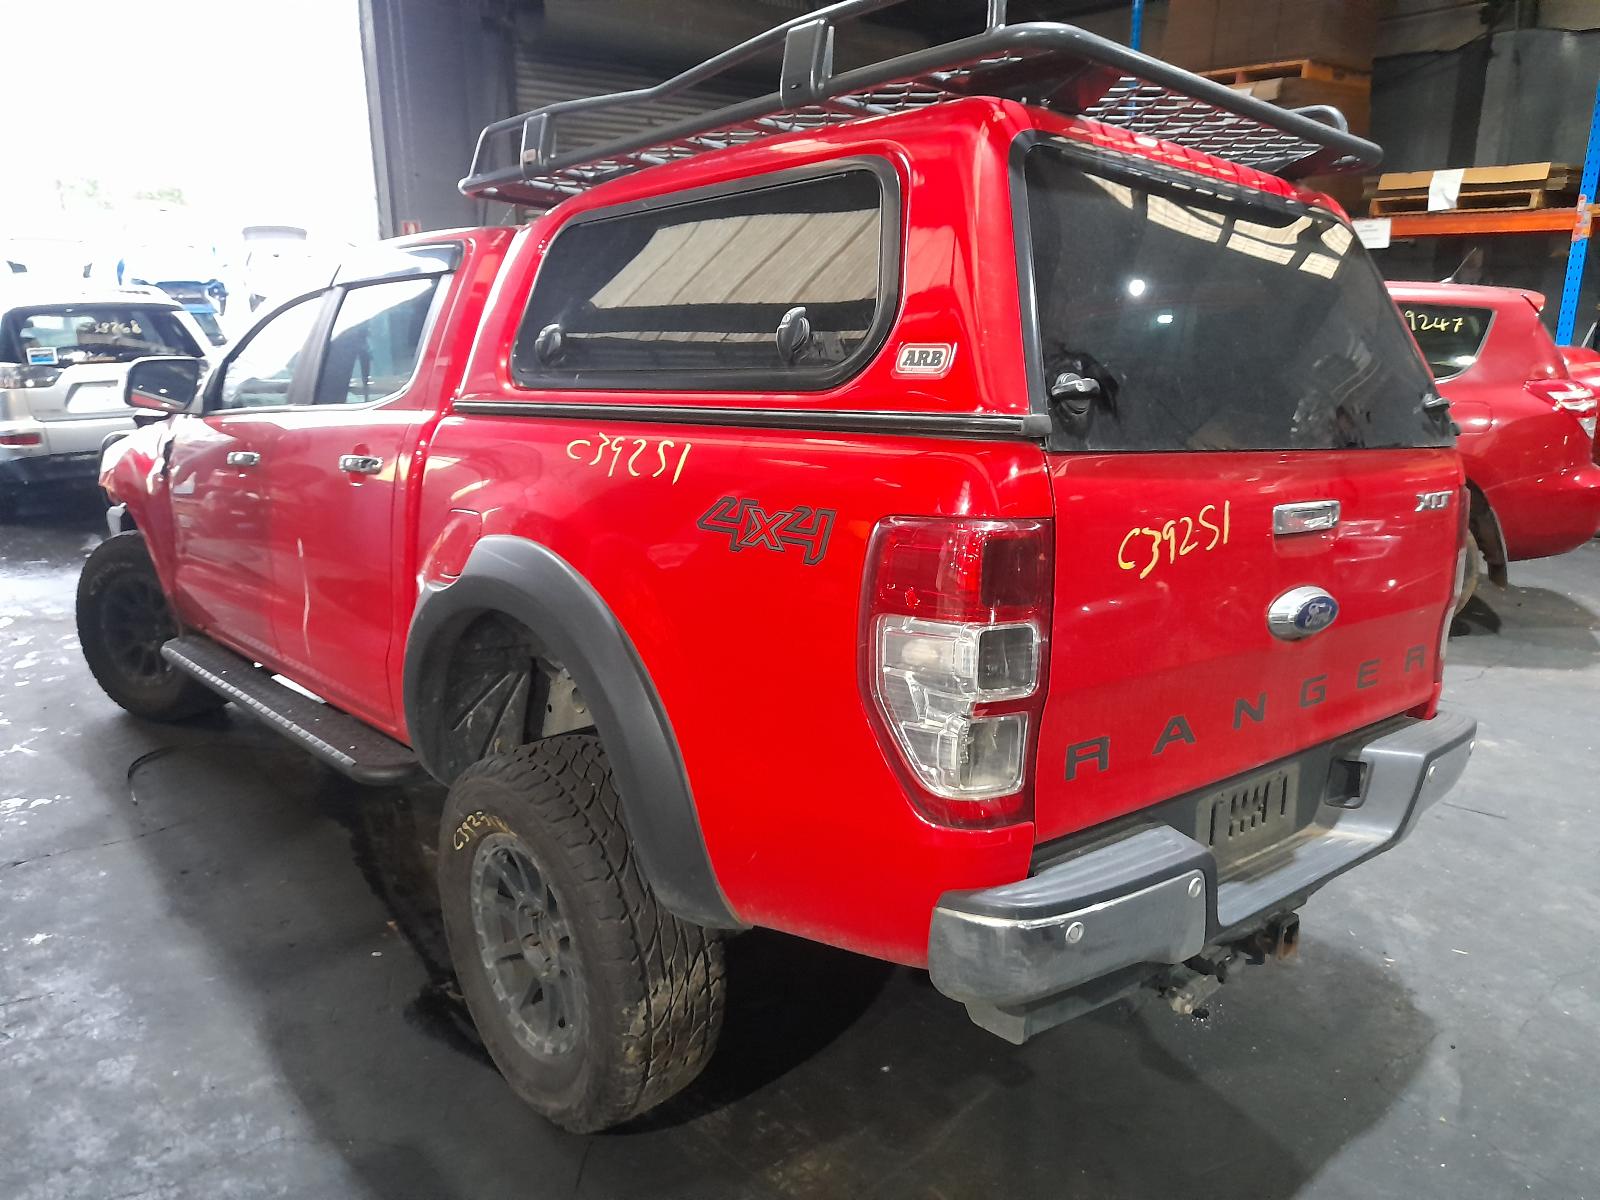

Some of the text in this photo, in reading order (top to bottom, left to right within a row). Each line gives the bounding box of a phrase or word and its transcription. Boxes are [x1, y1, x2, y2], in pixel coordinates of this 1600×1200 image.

[902, 350, 944, 366] ARB
[566, 432, 692, 485] C39251
[1117, 500, 1231, 580] C39251
[1064, 644, 1427, 781] RANGER
